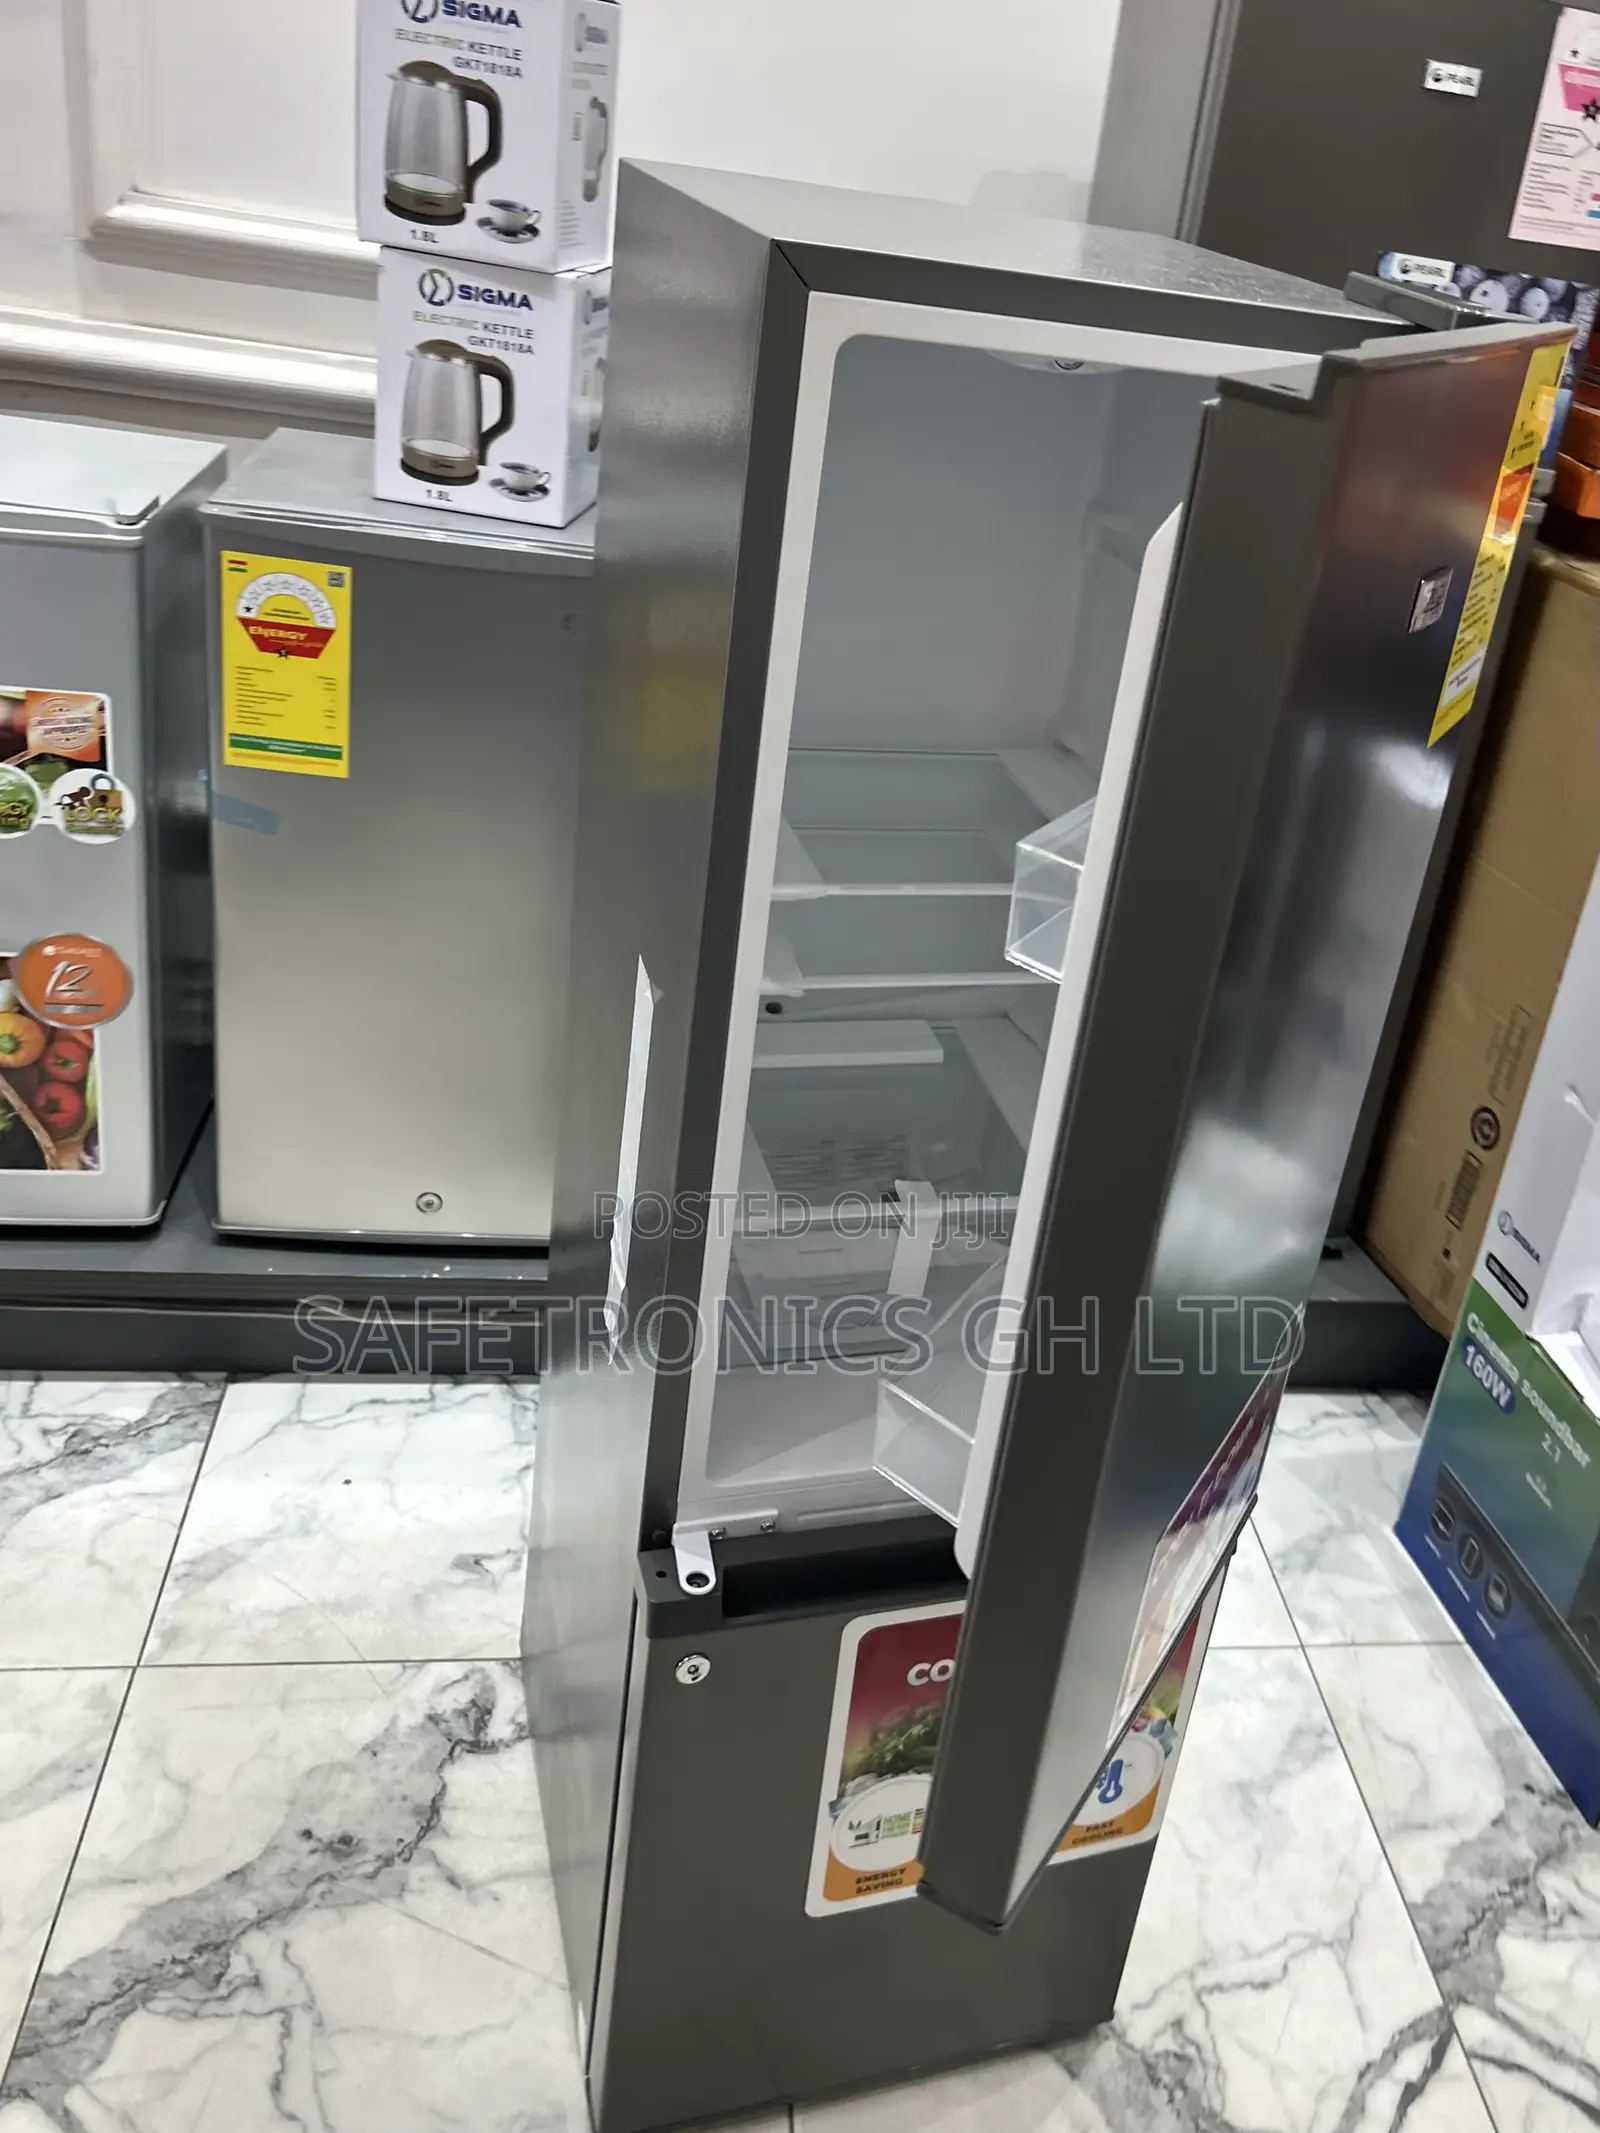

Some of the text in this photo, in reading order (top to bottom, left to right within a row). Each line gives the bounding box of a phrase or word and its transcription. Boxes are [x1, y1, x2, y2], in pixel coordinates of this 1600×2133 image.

[442, 0, 523, 29] SIGMA
[394, 28, 523, 61] ELECTRIC KETTLE
[456, 284, 534, 311] SIGMA
[412, 310, 535, 340] ELECTRIC KETTLE
[248, 626, 309, 641] ENERGY
[63, 805, 121, 823] LOCK
[1465, 1344, 1512, 1408] 160W
[1466, 1311, 1521, 1385] Cinema
[1521, 1378, 1592, 1469] soundbar
[856, 1868, 907, 1885] ENERGY
[856, 1878, 904, 1894] SAVING
